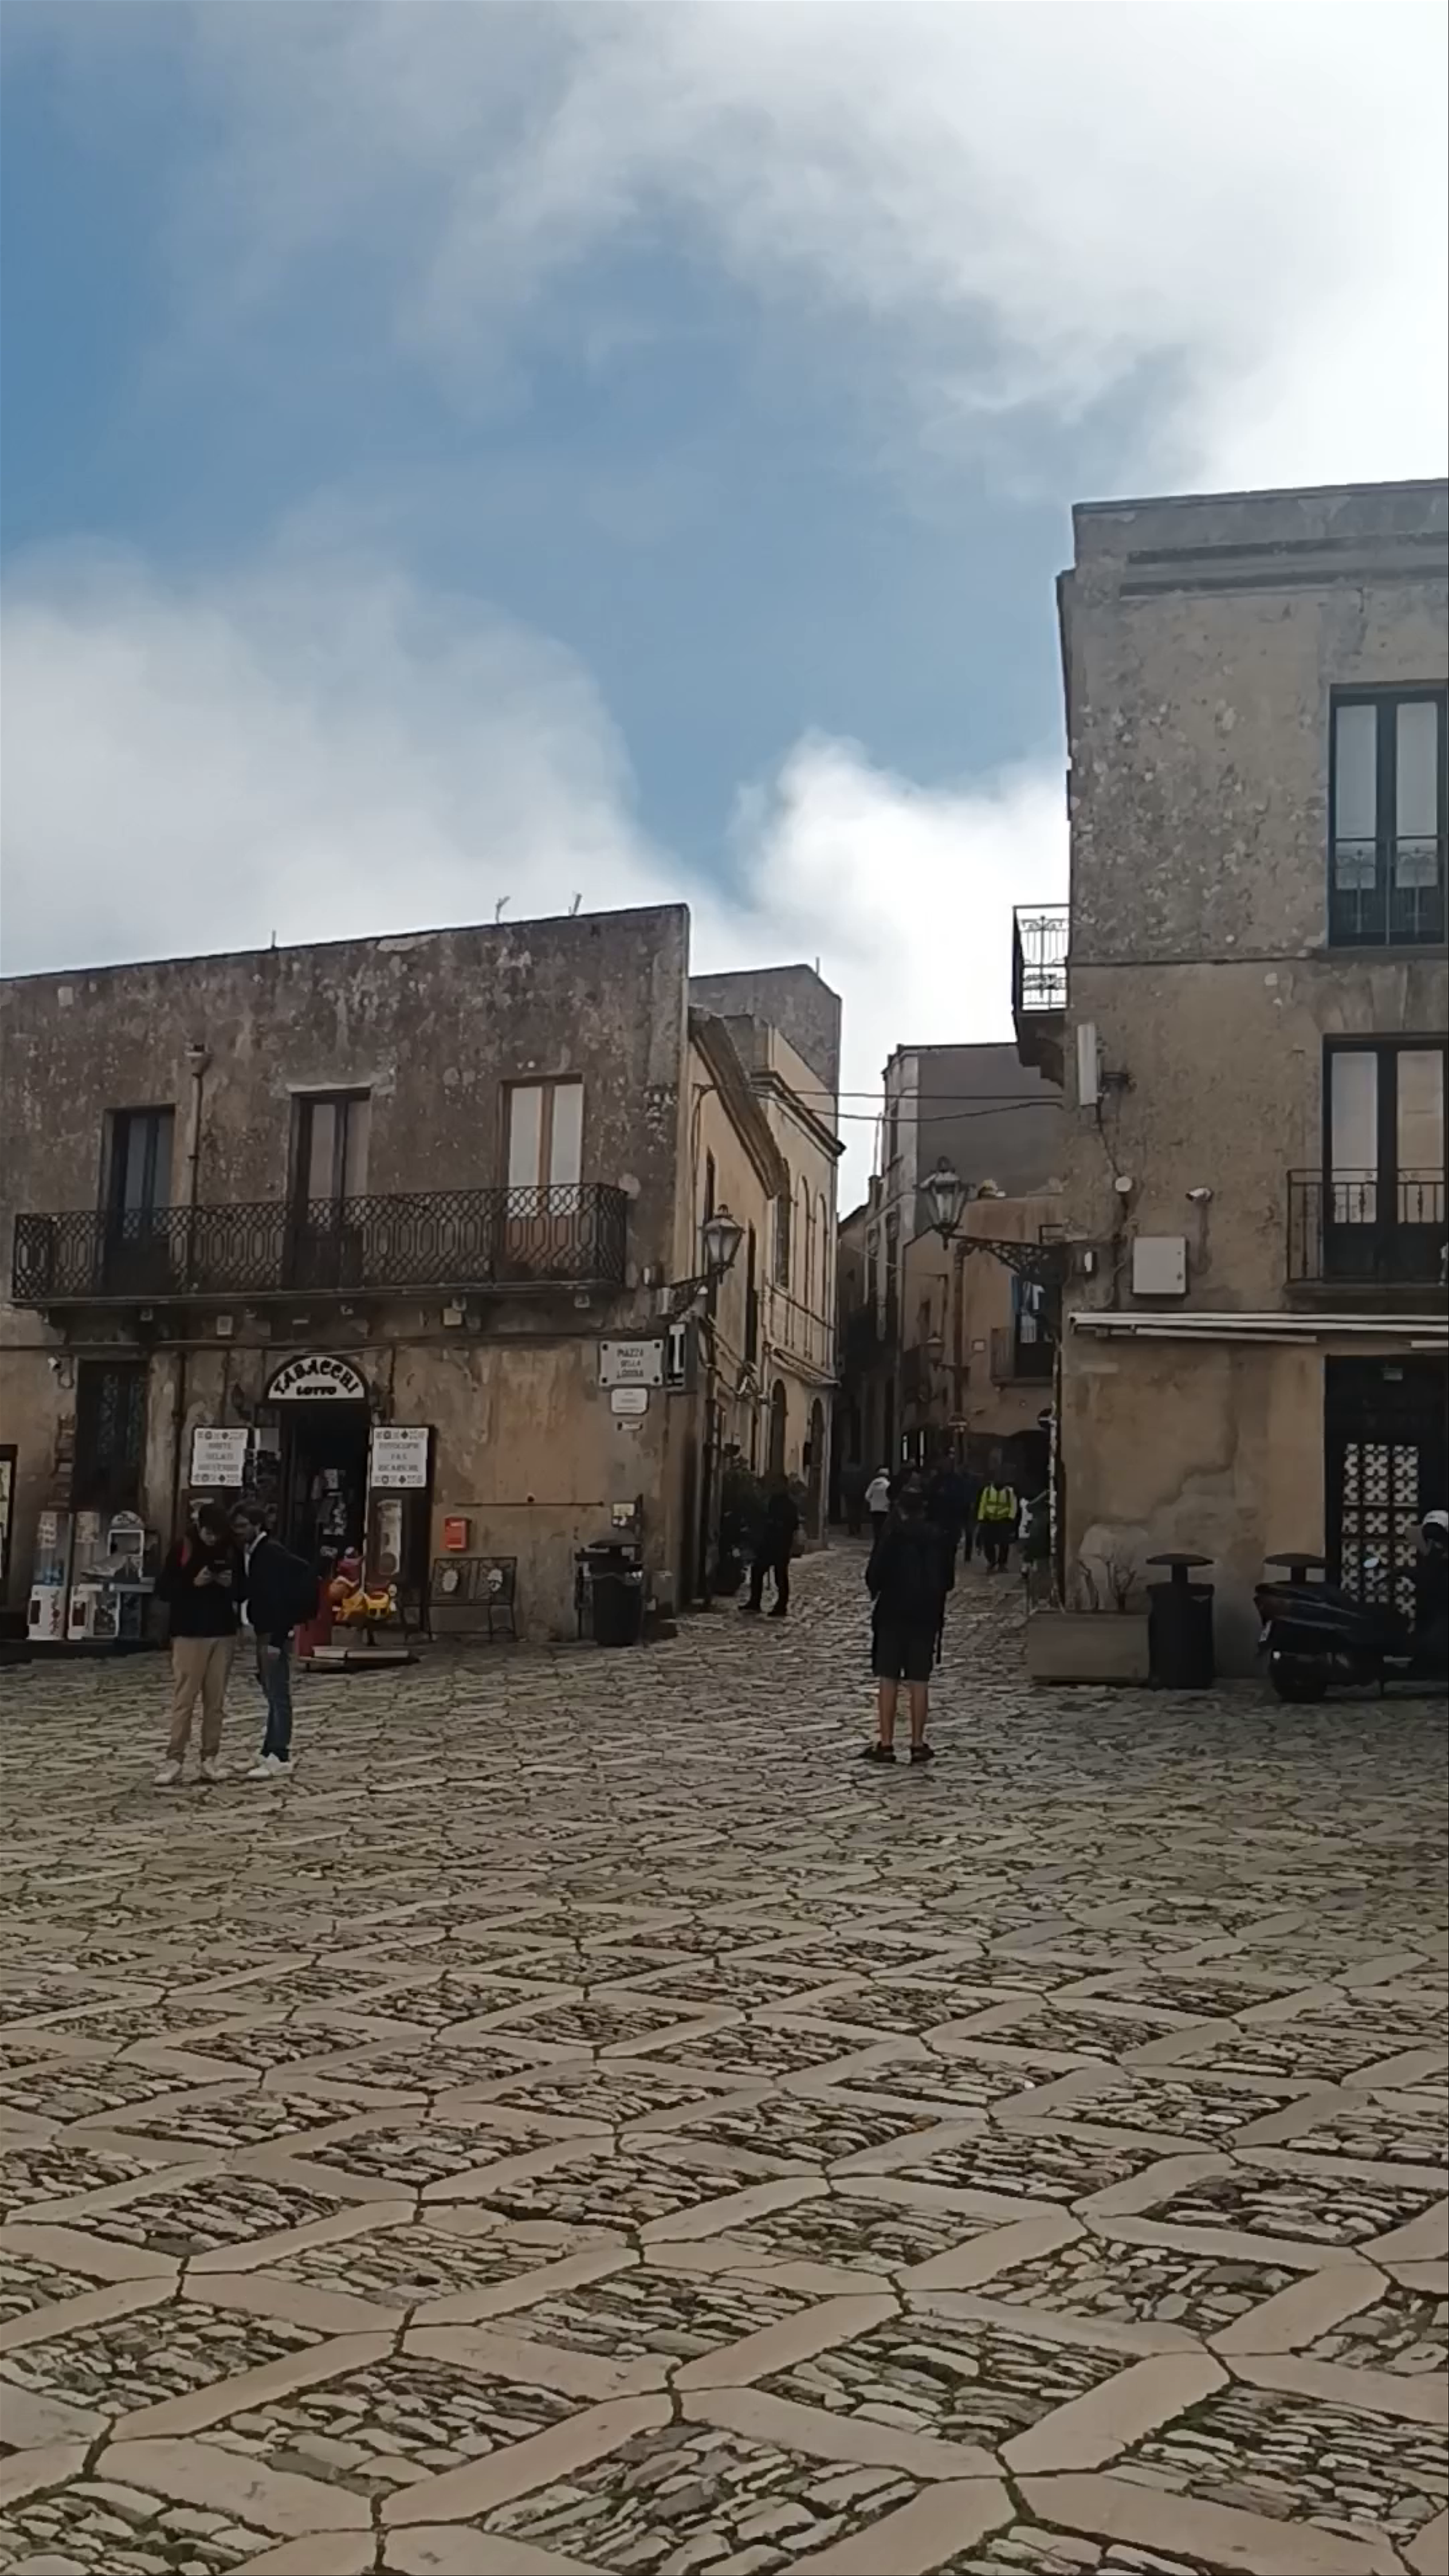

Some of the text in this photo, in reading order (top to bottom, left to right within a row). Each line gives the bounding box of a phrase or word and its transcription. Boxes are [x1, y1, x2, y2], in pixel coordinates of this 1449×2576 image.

[617, 1348, 644, 1358] PIAZZA
[274, 1359, 359, 1395] TABACCHI
[296, 1386, 337, 1395] LOTTO
